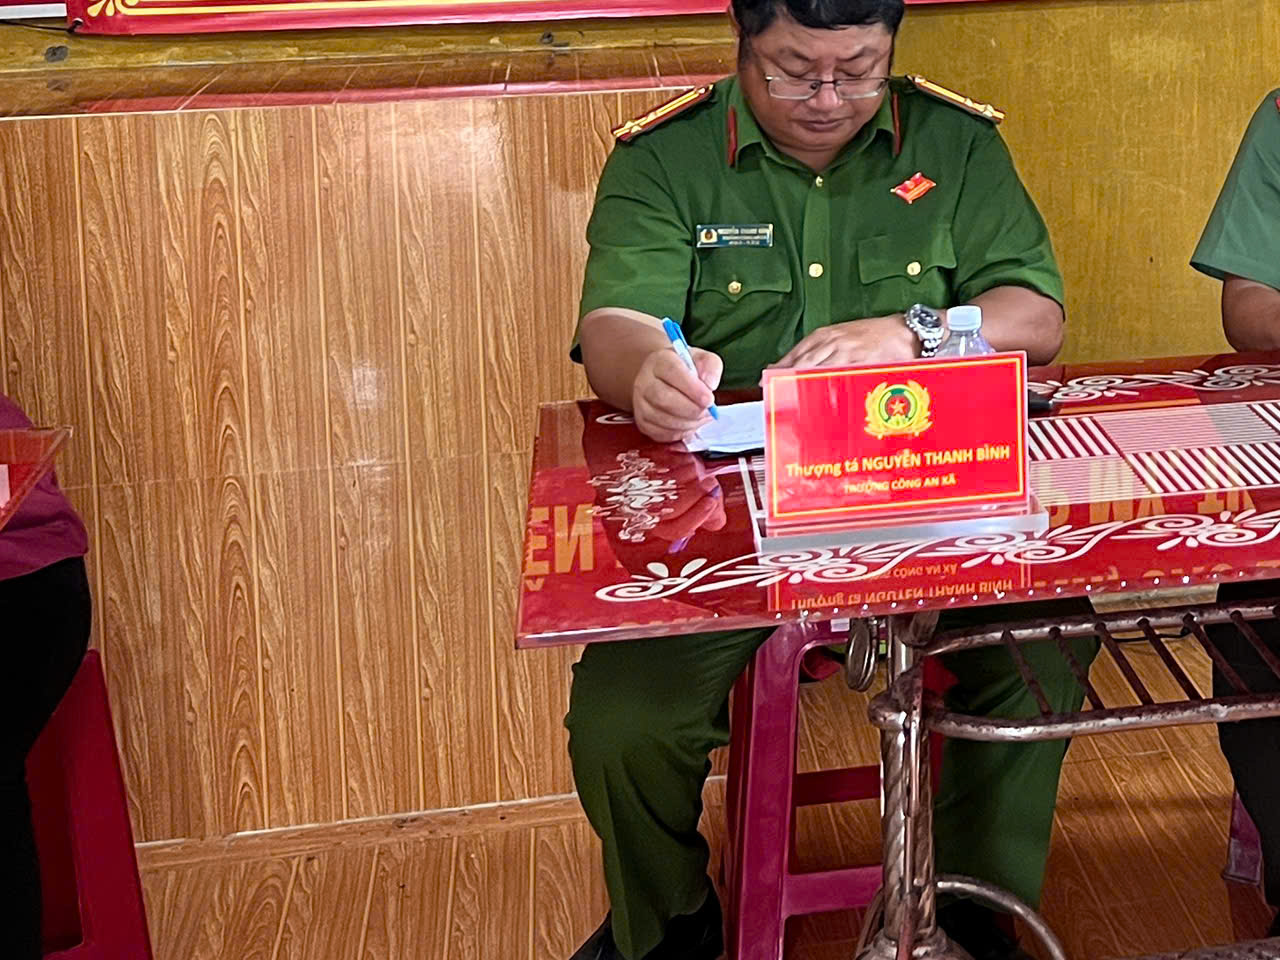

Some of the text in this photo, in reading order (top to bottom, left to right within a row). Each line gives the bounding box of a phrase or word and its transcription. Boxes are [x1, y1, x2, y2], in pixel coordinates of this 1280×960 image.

[786, 444, 1010, 478] Thượng tá NGUYỄN THANH BÌNH
[891, 476, 922, 490] CÔNG
[924, 477, 940, 488] AN
[942, 472, 957, 486] XÃ
